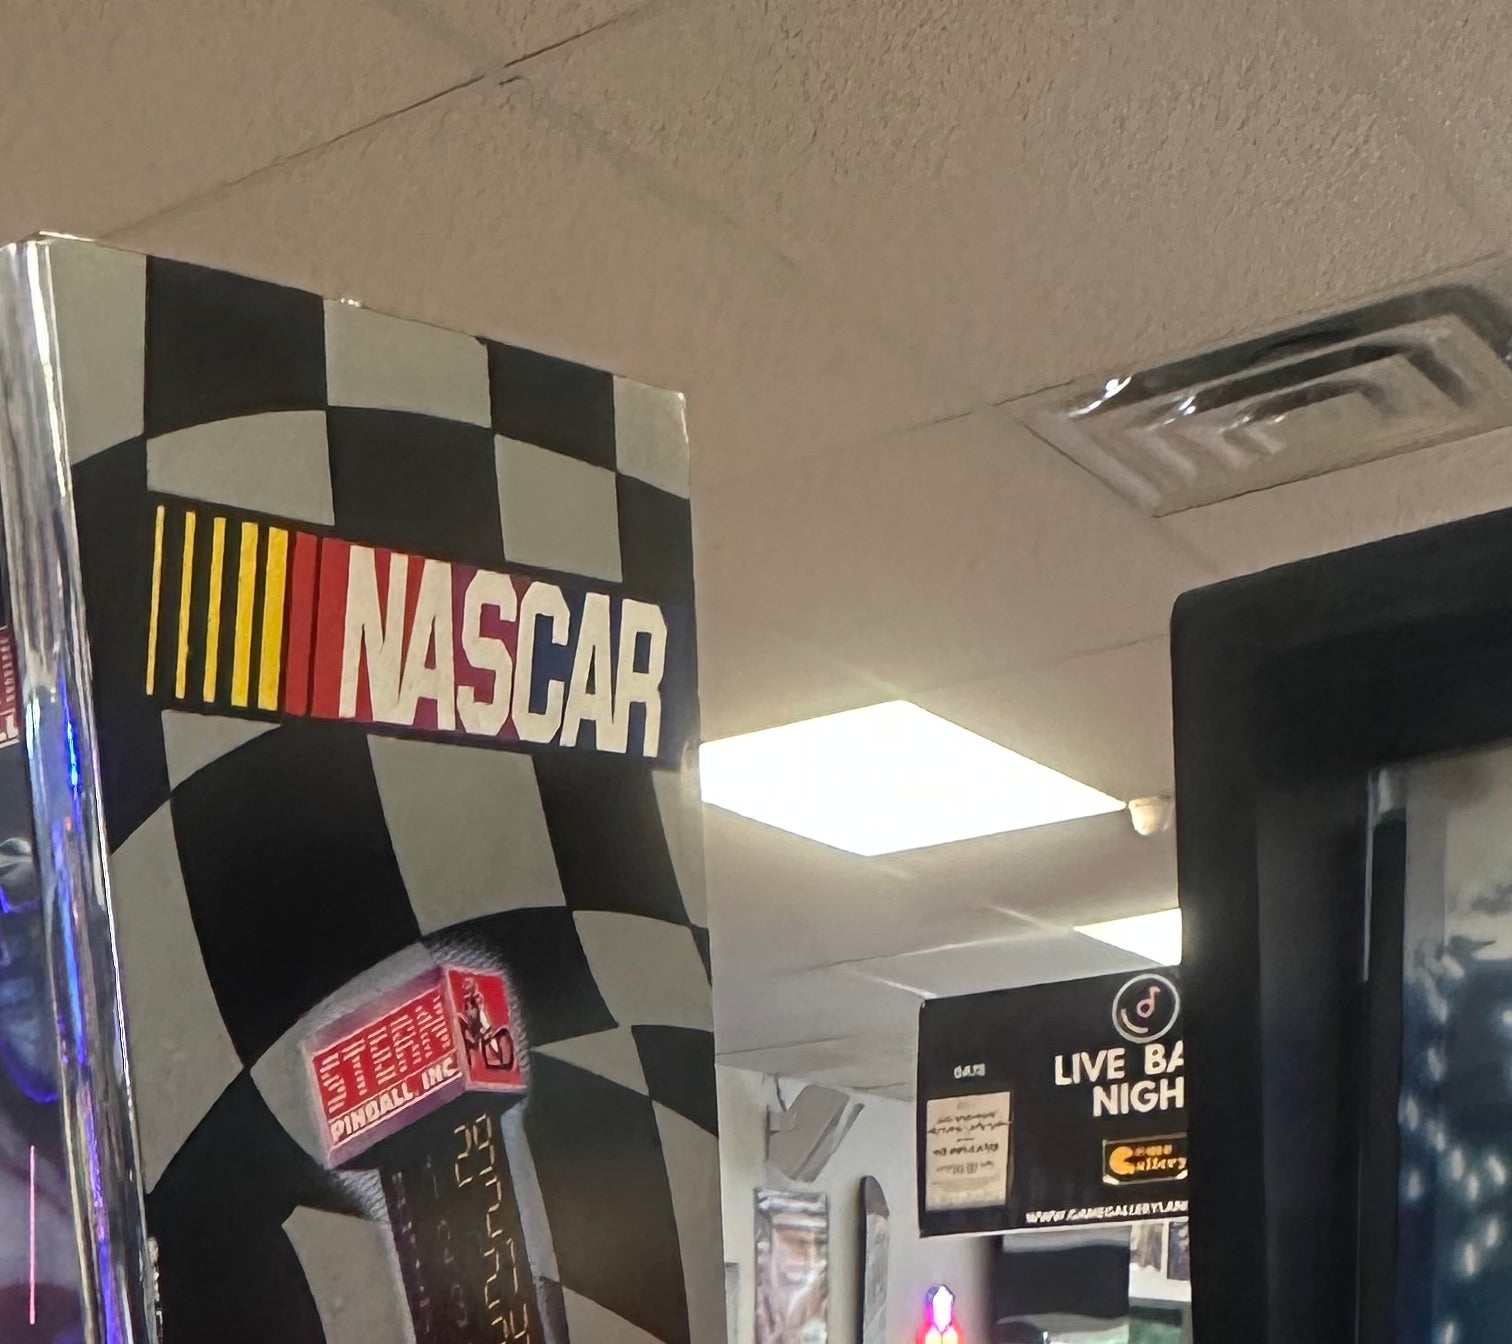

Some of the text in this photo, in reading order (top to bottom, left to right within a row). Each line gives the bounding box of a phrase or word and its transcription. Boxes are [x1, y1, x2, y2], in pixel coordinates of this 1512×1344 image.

[338, 544, 668, 758] NASCAR
[319, 993, 452, 1114] STERN
[1054, 1047, 1126, 1086] LIVE
[1092, 1076, 1185, 1117] NIGH
[453, 1113, 495, 1188] 29
[484, 1175, 504, 1239] 2
[483, 1237, 519, 1310] 21
